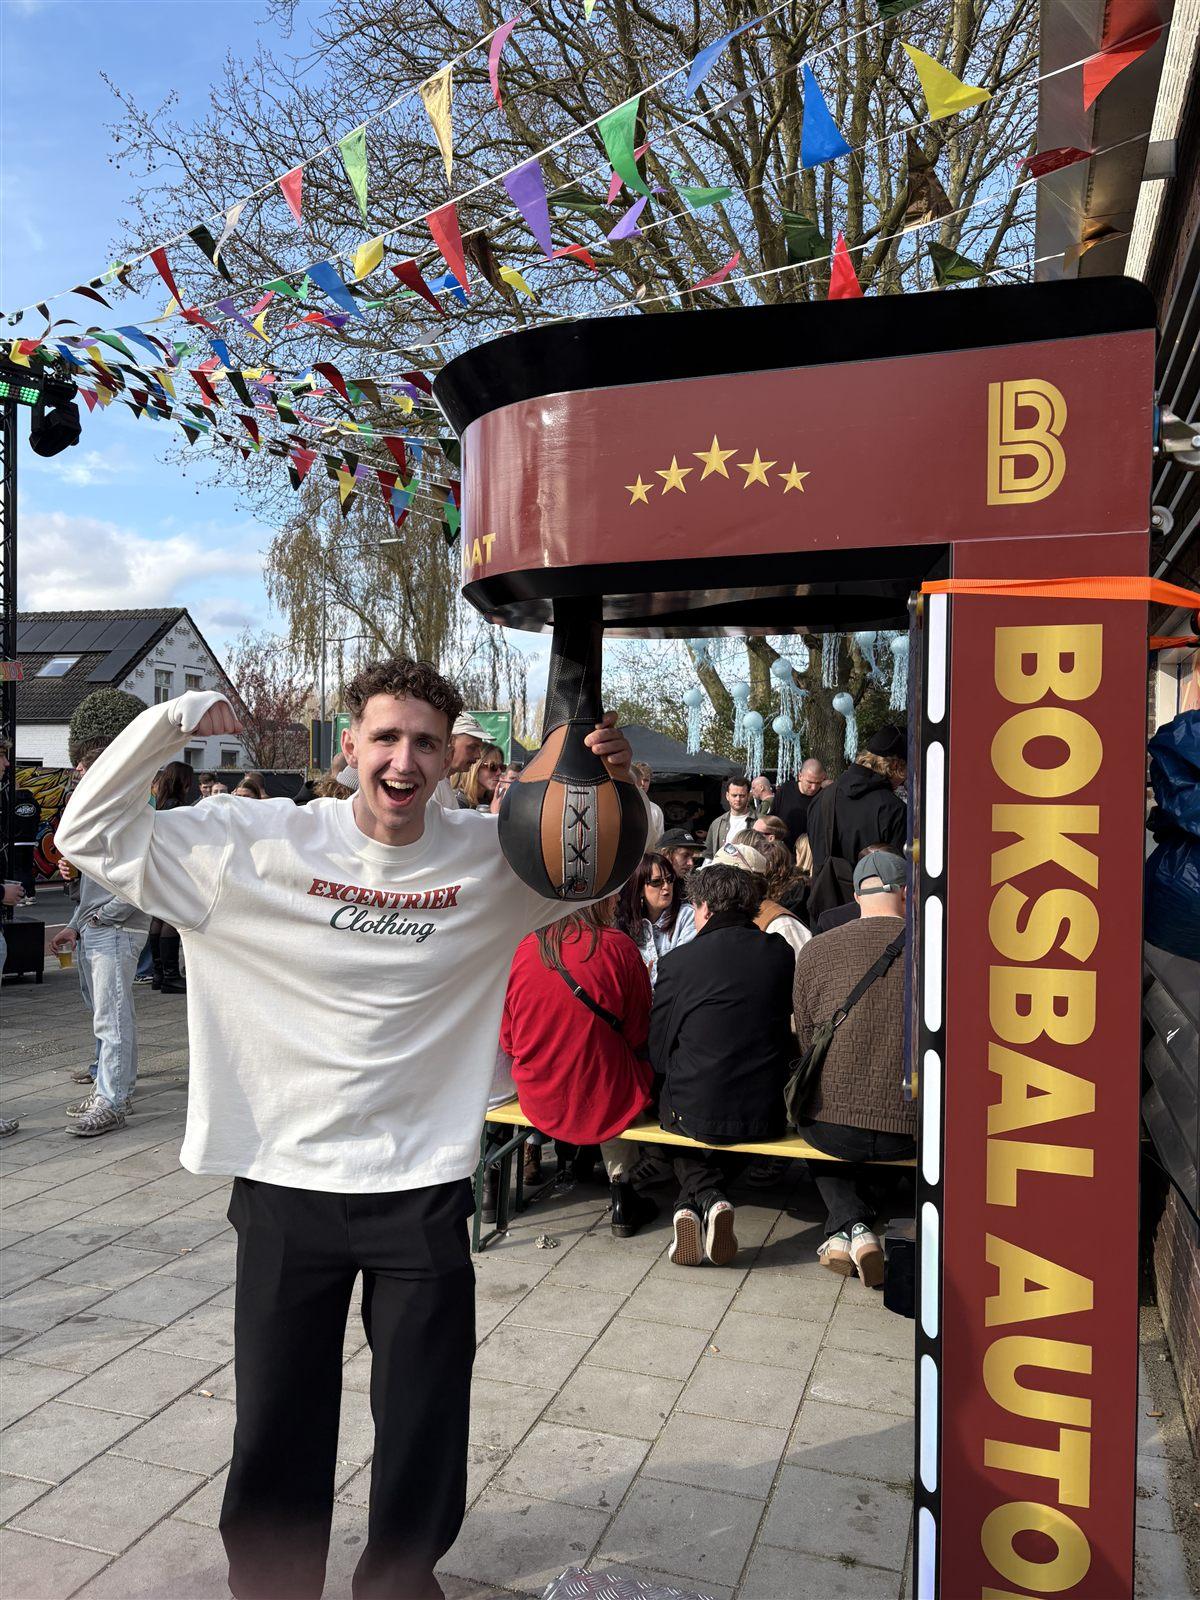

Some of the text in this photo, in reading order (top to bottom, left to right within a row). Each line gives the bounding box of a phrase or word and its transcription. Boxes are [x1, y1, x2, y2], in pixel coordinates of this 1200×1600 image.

[987, 379, 1067, 506] B
[307, 878, 462, 910] EXCENTRIEK
[329, 905, 437, 943] Clothing
[981, 623, 1104, 1600] BOKSBAL AUTO
